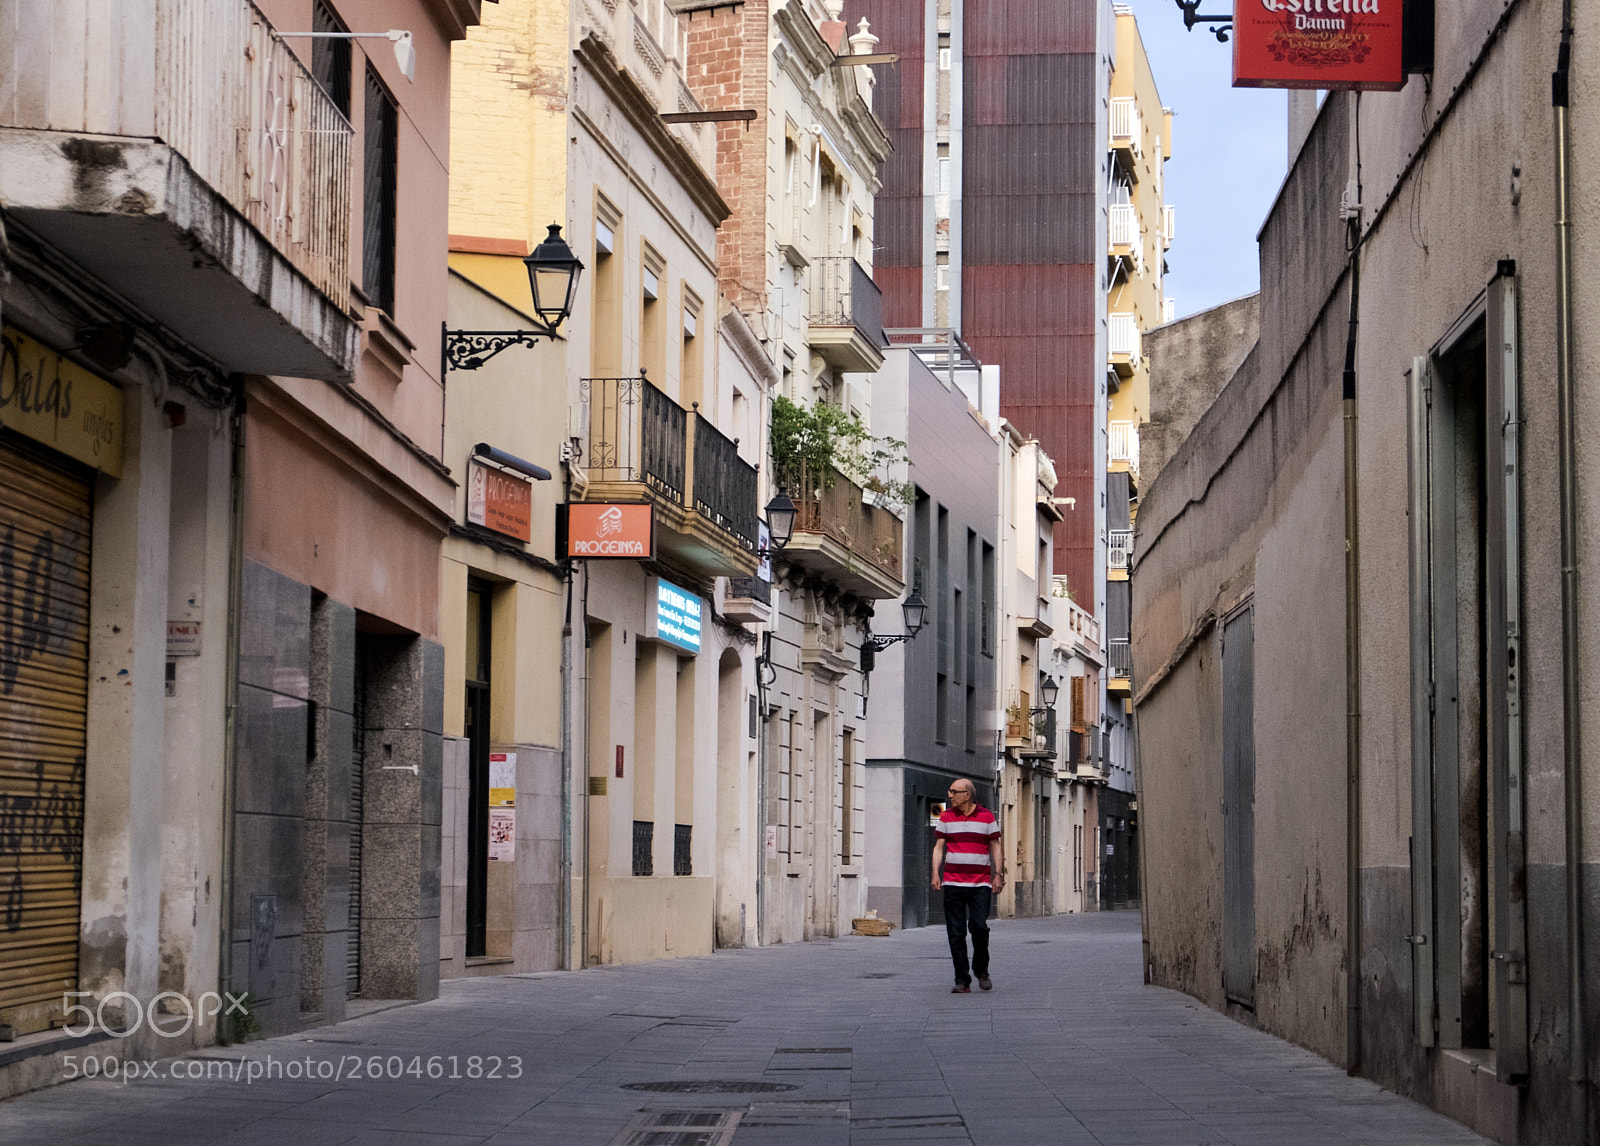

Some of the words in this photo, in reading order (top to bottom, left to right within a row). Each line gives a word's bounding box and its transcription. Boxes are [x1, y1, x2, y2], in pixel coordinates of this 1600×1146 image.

[1294, 13, 1345, 30] Damm
[1289, 39, 1329, 49] LAGER
[574, 540, 644, 554] PROGEINSA
